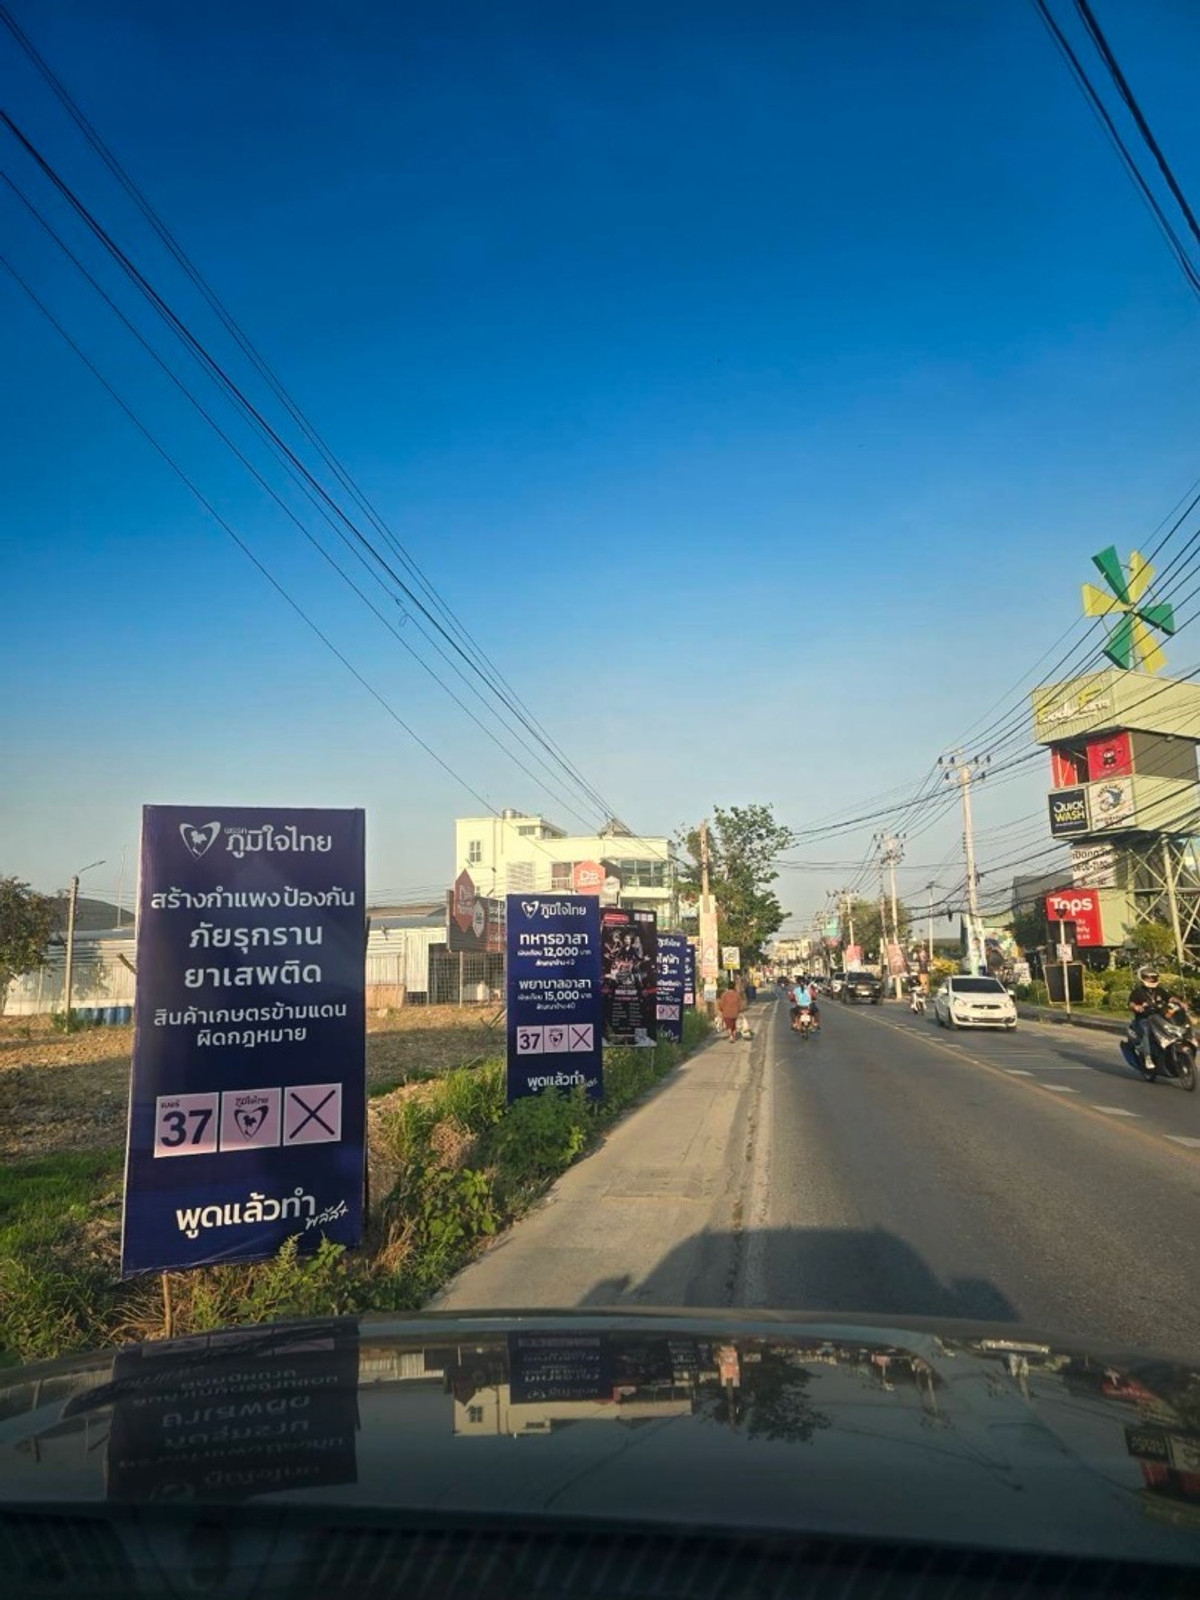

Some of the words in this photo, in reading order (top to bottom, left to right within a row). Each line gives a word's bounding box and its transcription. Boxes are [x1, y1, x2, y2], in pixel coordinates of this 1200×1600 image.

[1053, 800, 1085, 814] QUICK
[1054, 811, 1086, 823] WASH
[225, 824, 333, 858] ภูมิใจไทย
[150, 886, 355, 909] สร้างกำแพงป้องกัน
[1049, 897, 1093, 916] Tops
[189, 921, 323, 954] ภัยรุกราน
[519, 933, 589, 945] ทหารอาสา
[543, 946, 579, 958] 12,000
[184, 959, 322, 988] ยาเสพติด
[518, 979, 592, 990] พยาบาลอาสา
[544, 990, 579, 1002] 15,000
[153, 1002, 347, 1027] สินค้าเกษตรข้ามแดน
[196, 1027, 307, 1047] ผิดกฎหมาย
[519, 1033, 541, 1050] 37
[527, 1069, 585, 1092] พูดแล้วทำ
[160, 1108, 213, 1148] 37
[175, 1187, 316, 1239] พูดแล้วทำ
